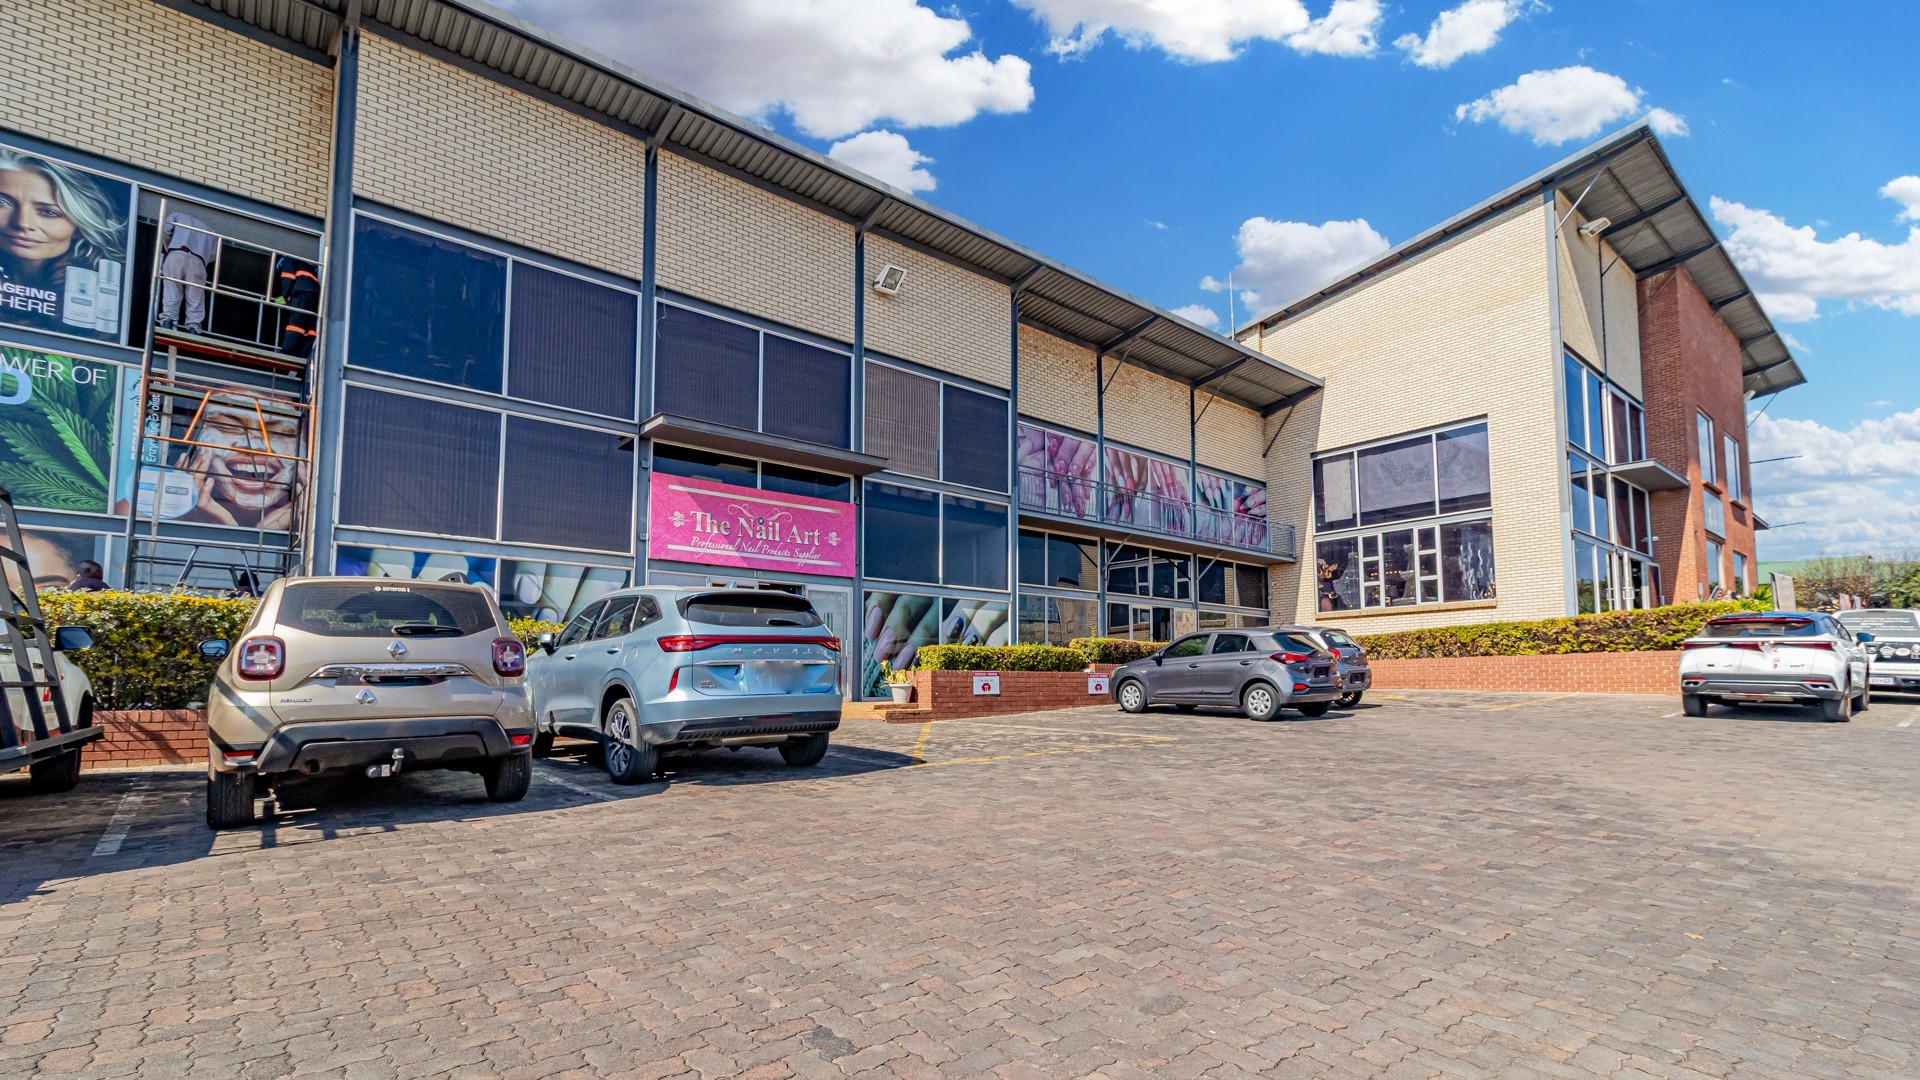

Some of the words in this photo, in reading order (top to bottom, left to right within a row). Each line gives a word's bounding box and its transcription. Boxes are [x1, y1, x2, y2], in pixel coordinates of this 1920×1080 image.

[0, 293, 56, 316] HERE
[71, 365, 107, 385] OF
[690, 511, 731, 536] The
[737, 517, 780, 541] Nail
[787, 524, 821, 546] Art
[690, 533, 742, 557] Professional
[740, 541, 763, 553] Nail
[761, 542, 791, 557] Products
[793, 546, 821, 566] Supplier
[753, 570, 763, 579] 10
